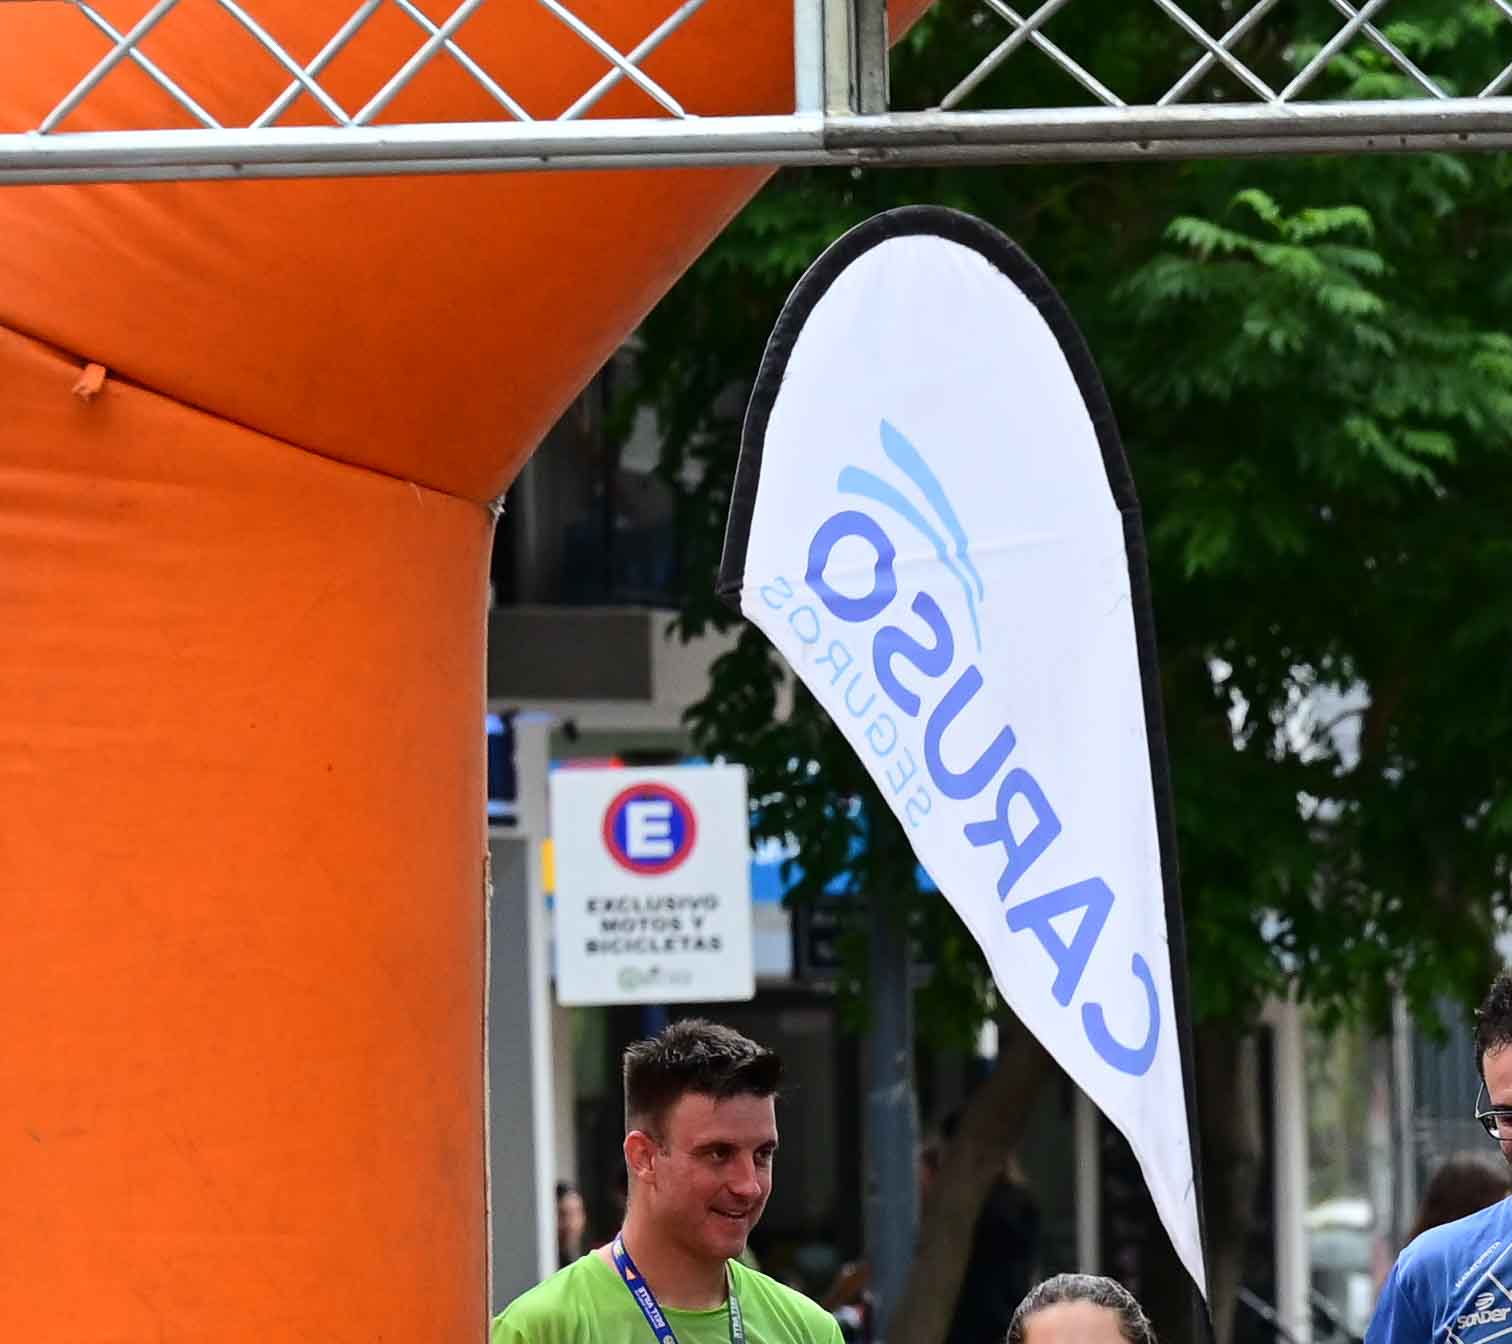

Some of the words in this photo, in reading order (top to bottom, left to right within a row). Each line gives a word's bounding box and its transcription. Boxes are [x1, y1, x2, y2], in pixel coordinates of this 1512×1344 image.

[626, 800, 675, 859] E
[587, 894, 717, 914] EXCLUSIVO
[601, 916, 681, 932] MOTOS
[693, 916, 704, 929] Y
[586, 937, 723, 954] BICICLETAS
